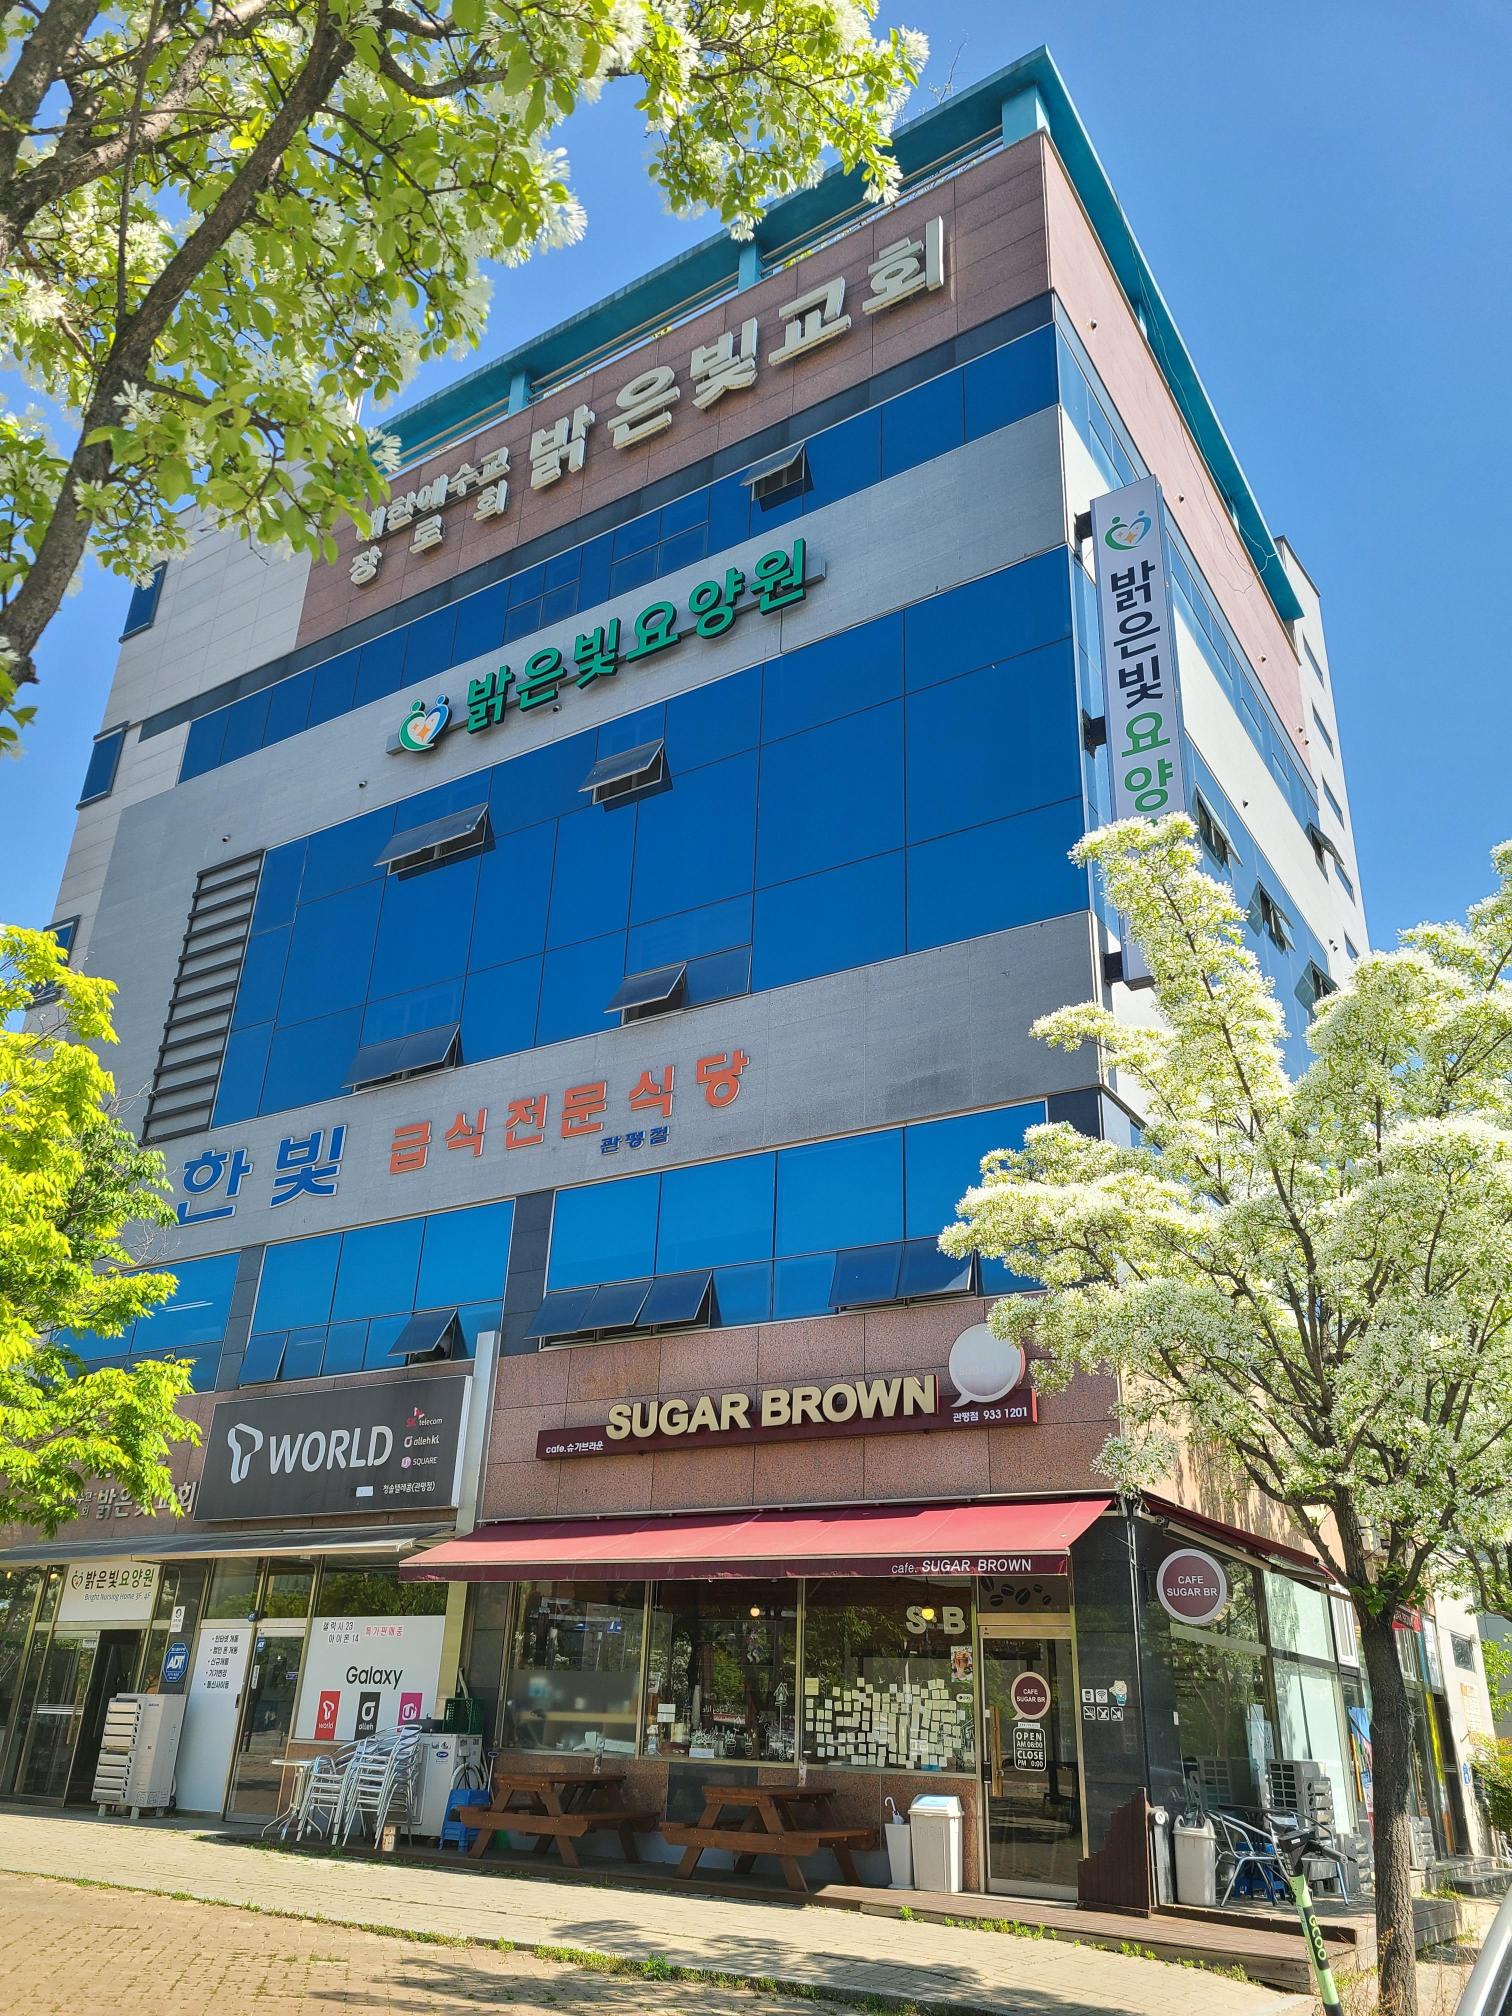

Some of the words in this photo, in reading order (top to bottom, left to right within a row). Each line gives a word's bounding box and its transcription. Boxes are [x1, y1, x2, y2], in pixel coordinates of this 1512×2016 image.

[529, 214, 945, 491] 밝은빛교회
[466, 537, 807, 735] 밝은빛요양원
[1110, 559, 1176, 825] 밝은빛요양
[600, 1126, 670, 1155] 관평점
[175, 1124, 348, 1228] 한빛
[605, 1391, 751, 1440] SUGAR
[760, 1373, 938, 1427] BROWN
[953, 1411, 979, 1423] 관평점
[983, 1409, 1002, 1420] 933
[1004, 1406, 1028, 1418] 1201
[419, 1418, 443, 1427] telecom
[269, 1425, 394, 1475] WORLD
[412, 1456, 438, 1466] SQUARE
[891, 1562, 918, 1574] cafe.
[921, 1559, 971, 1572] SUGAR
[977, 1558, 1032, 1572] BROWN
[84, 1567, 155, 1590] 밝은빛요양원
[1177, 1575, 1204, 1584] CAFE
[1166, 1587, 1201, 1597] SUGAR
[1203, 1587, 1218, 1597] BR
[345, 1621, 354, 1631] 23
[351, 1633, 360, 1643] 14
[166, 1655, 185, 1670] ADT
[346, 1665, 404, 1690] Galaxy
[1022, 1688, 1039, 1696] CAFE
[1015, 1731, 1042, 1741] OPEN
[1016, 1740, 1027, 1748] AM
[1017, 1750, 1044, 1760] CLOSE
[1017, 1759, 1027, 1767] PM
[1308, 1914, 1327, 1961] GCOO
